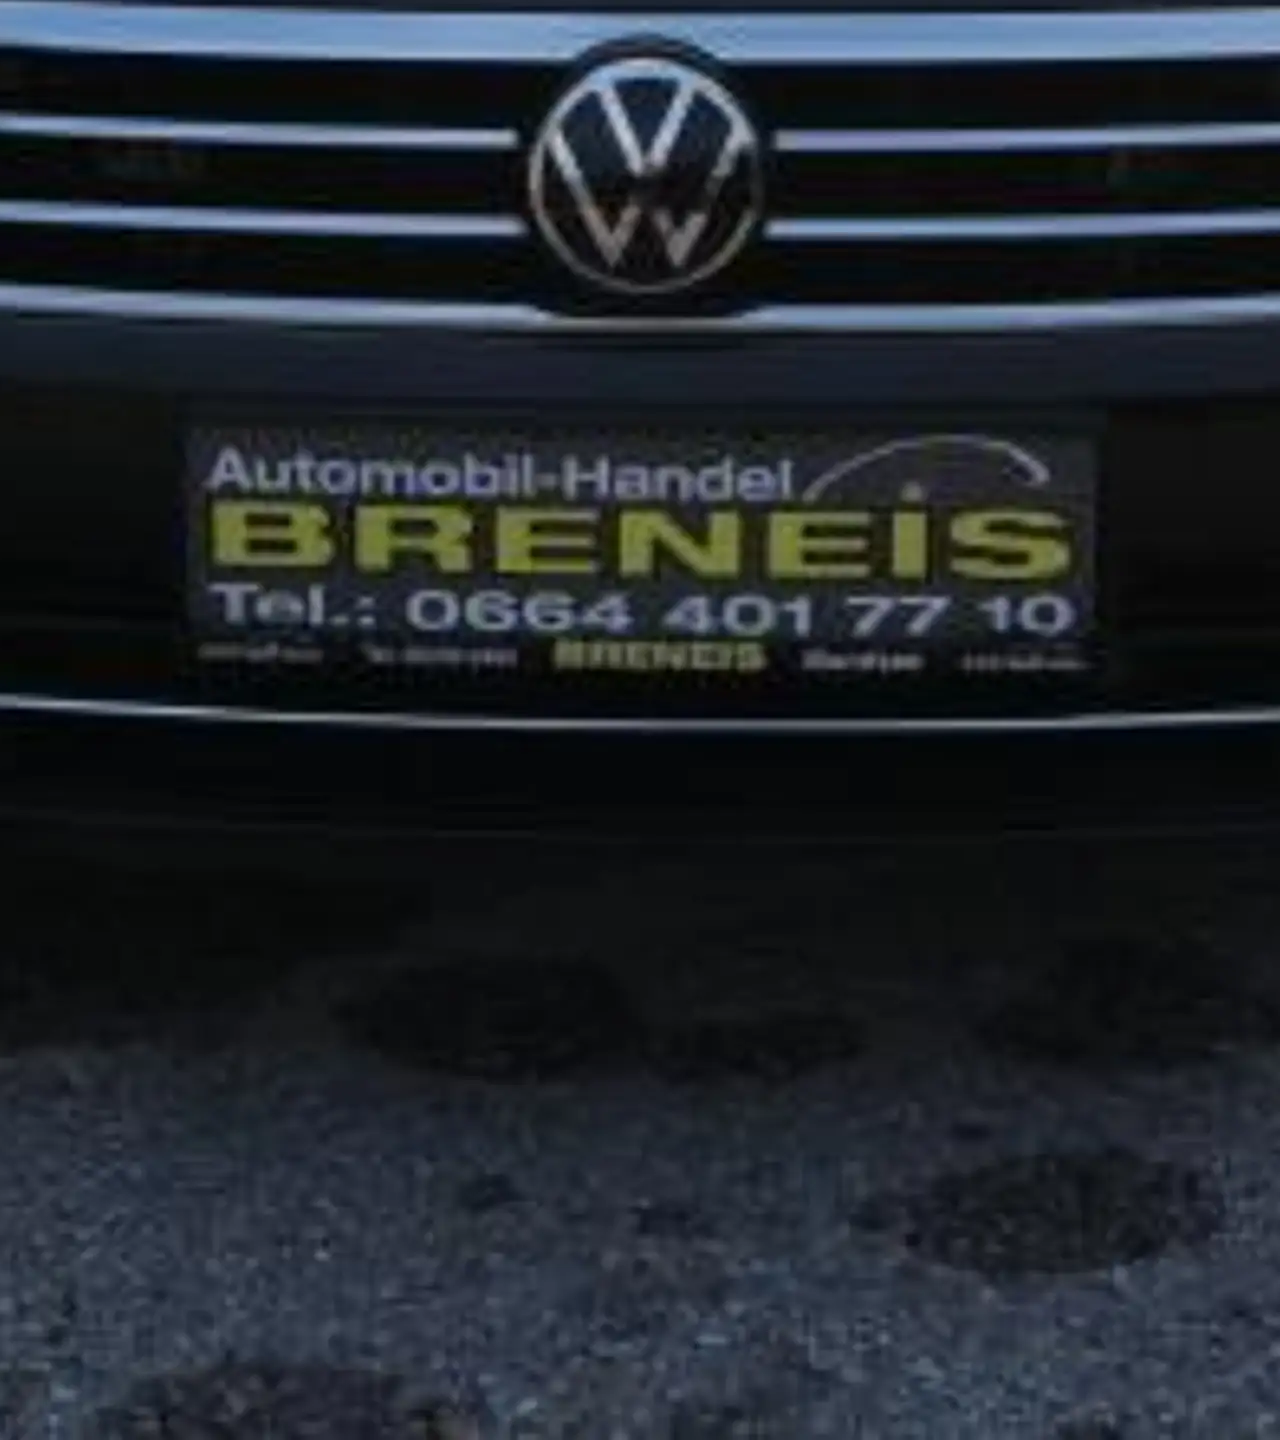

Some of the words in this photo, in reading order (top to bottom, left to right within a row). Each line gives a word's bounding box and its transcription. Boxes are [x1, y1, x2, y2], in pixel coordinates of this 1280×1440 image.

[205, 446, 796, 501] Automobil-Handel
[208, 582, 376, 626] Tel.:
[404, 587, 633, 633] 0664
[662, 593, 811, 636] 401
[842, 595, 952, 635] 77
[980, 595, 1076, 636] 10
